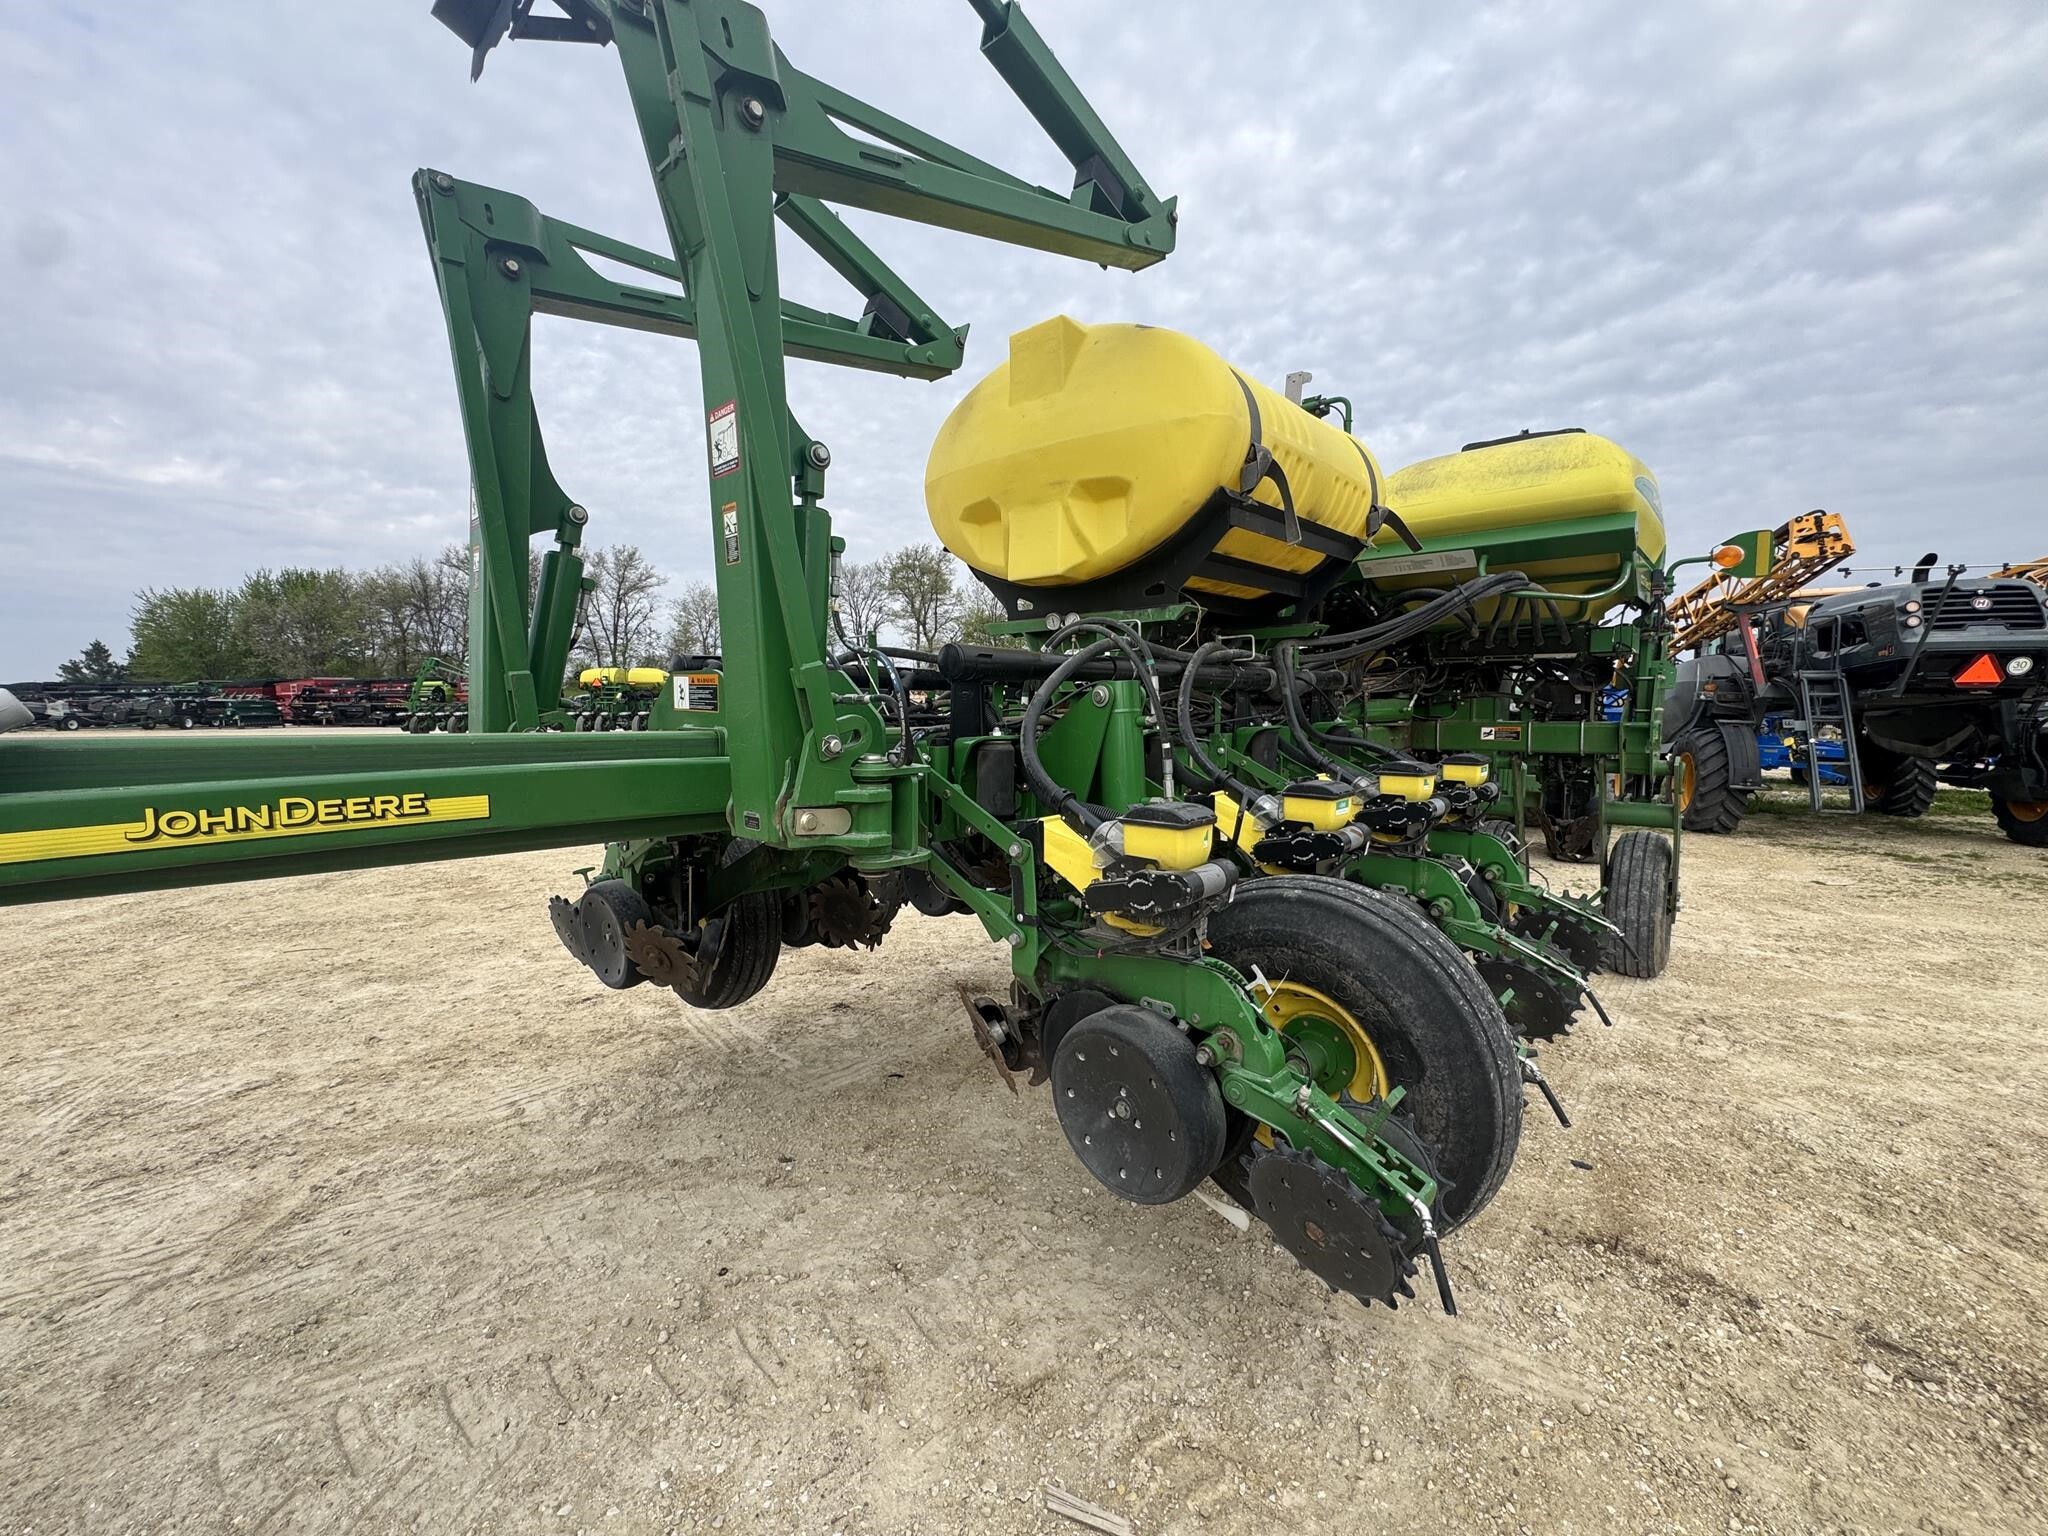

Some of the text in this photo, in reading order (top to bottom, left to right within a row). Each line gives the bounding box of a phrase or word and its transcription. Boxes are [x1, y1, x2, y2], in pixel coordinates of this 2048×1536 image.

[714, 403, 735, 418] DANGER
[2013, 661, 2028, 669] 30
[125, 793, 429, 842] JOHN DEERE
